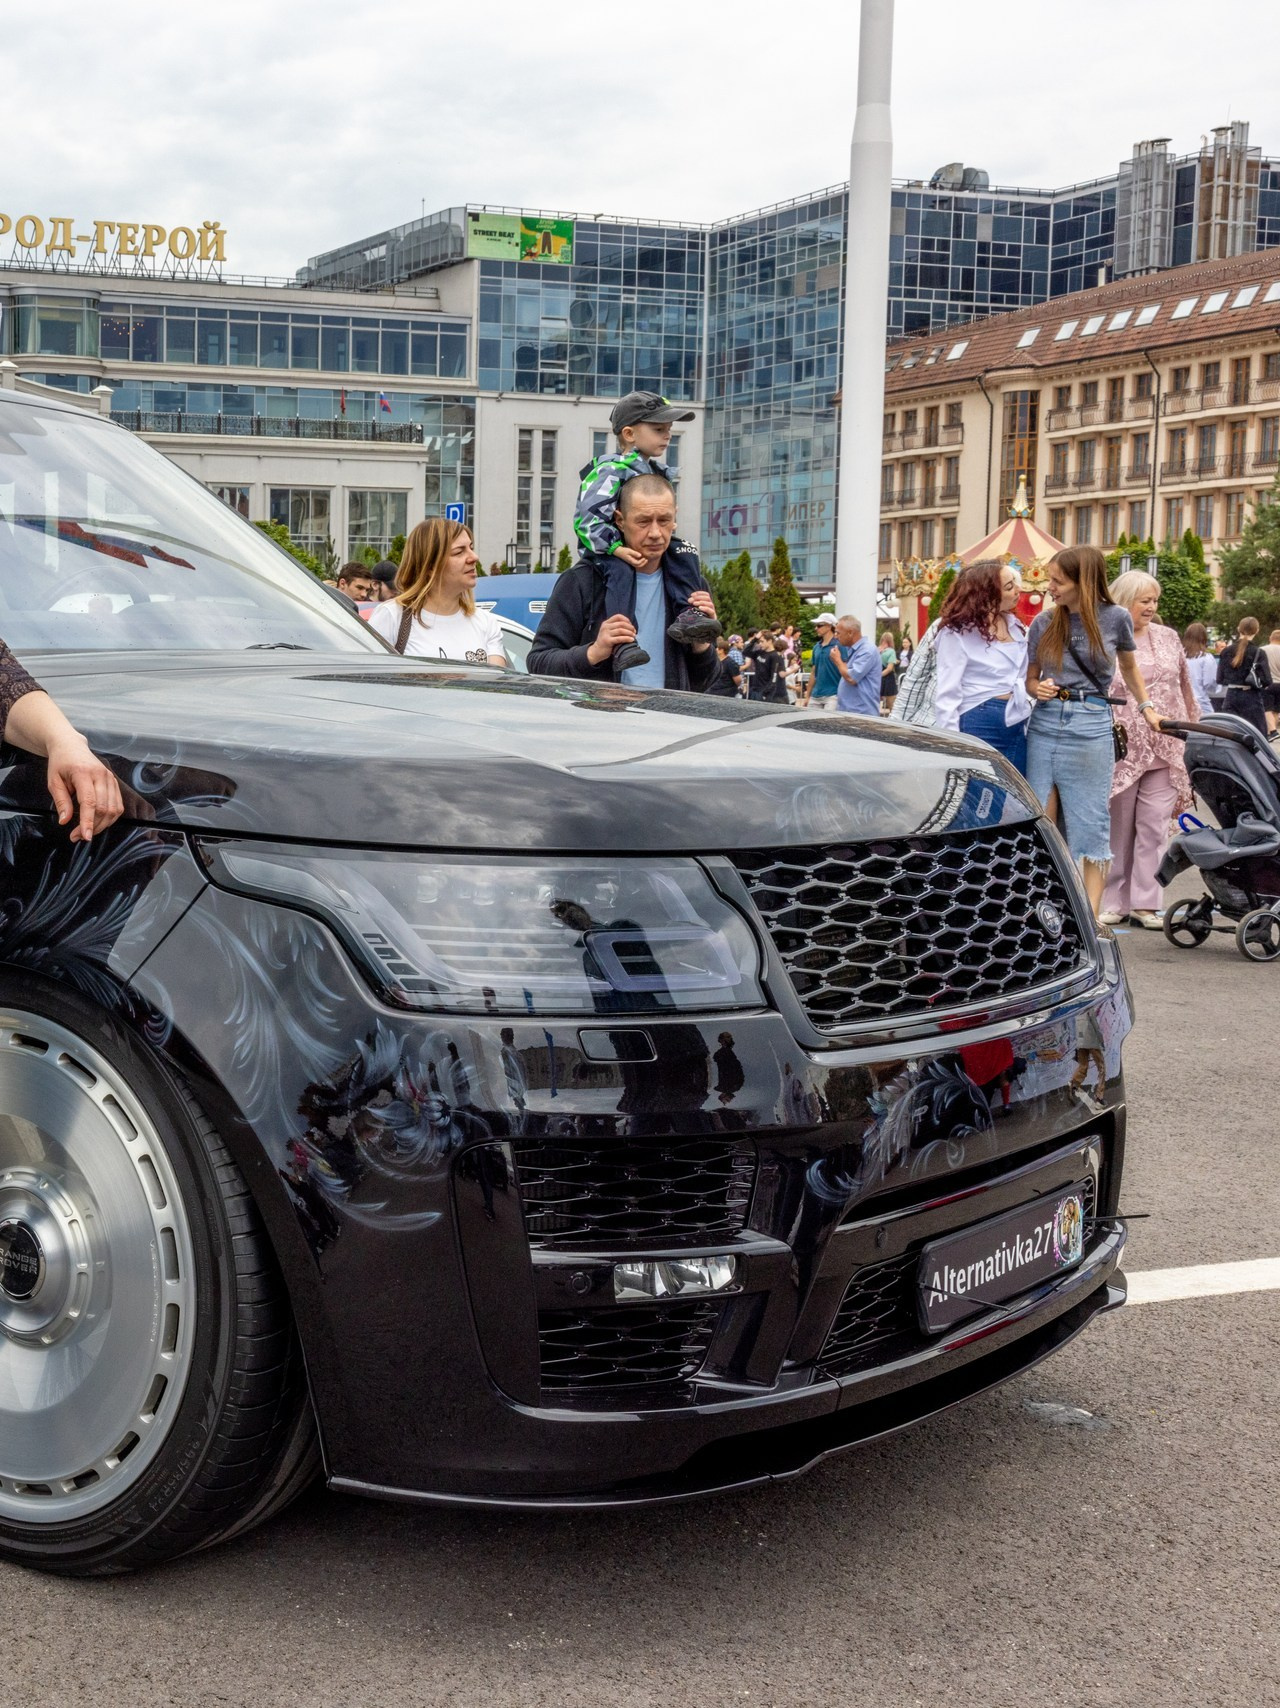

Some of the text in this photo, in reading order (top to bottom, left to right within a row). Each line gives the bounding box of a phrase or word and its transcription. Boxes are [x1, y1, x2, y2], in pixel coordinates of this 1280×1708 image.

[473, 229, 497, 237] STREET
[782, 502, 825, 520] ИПЕР
[928, 1221, 1053, 1307] Alternativka27
